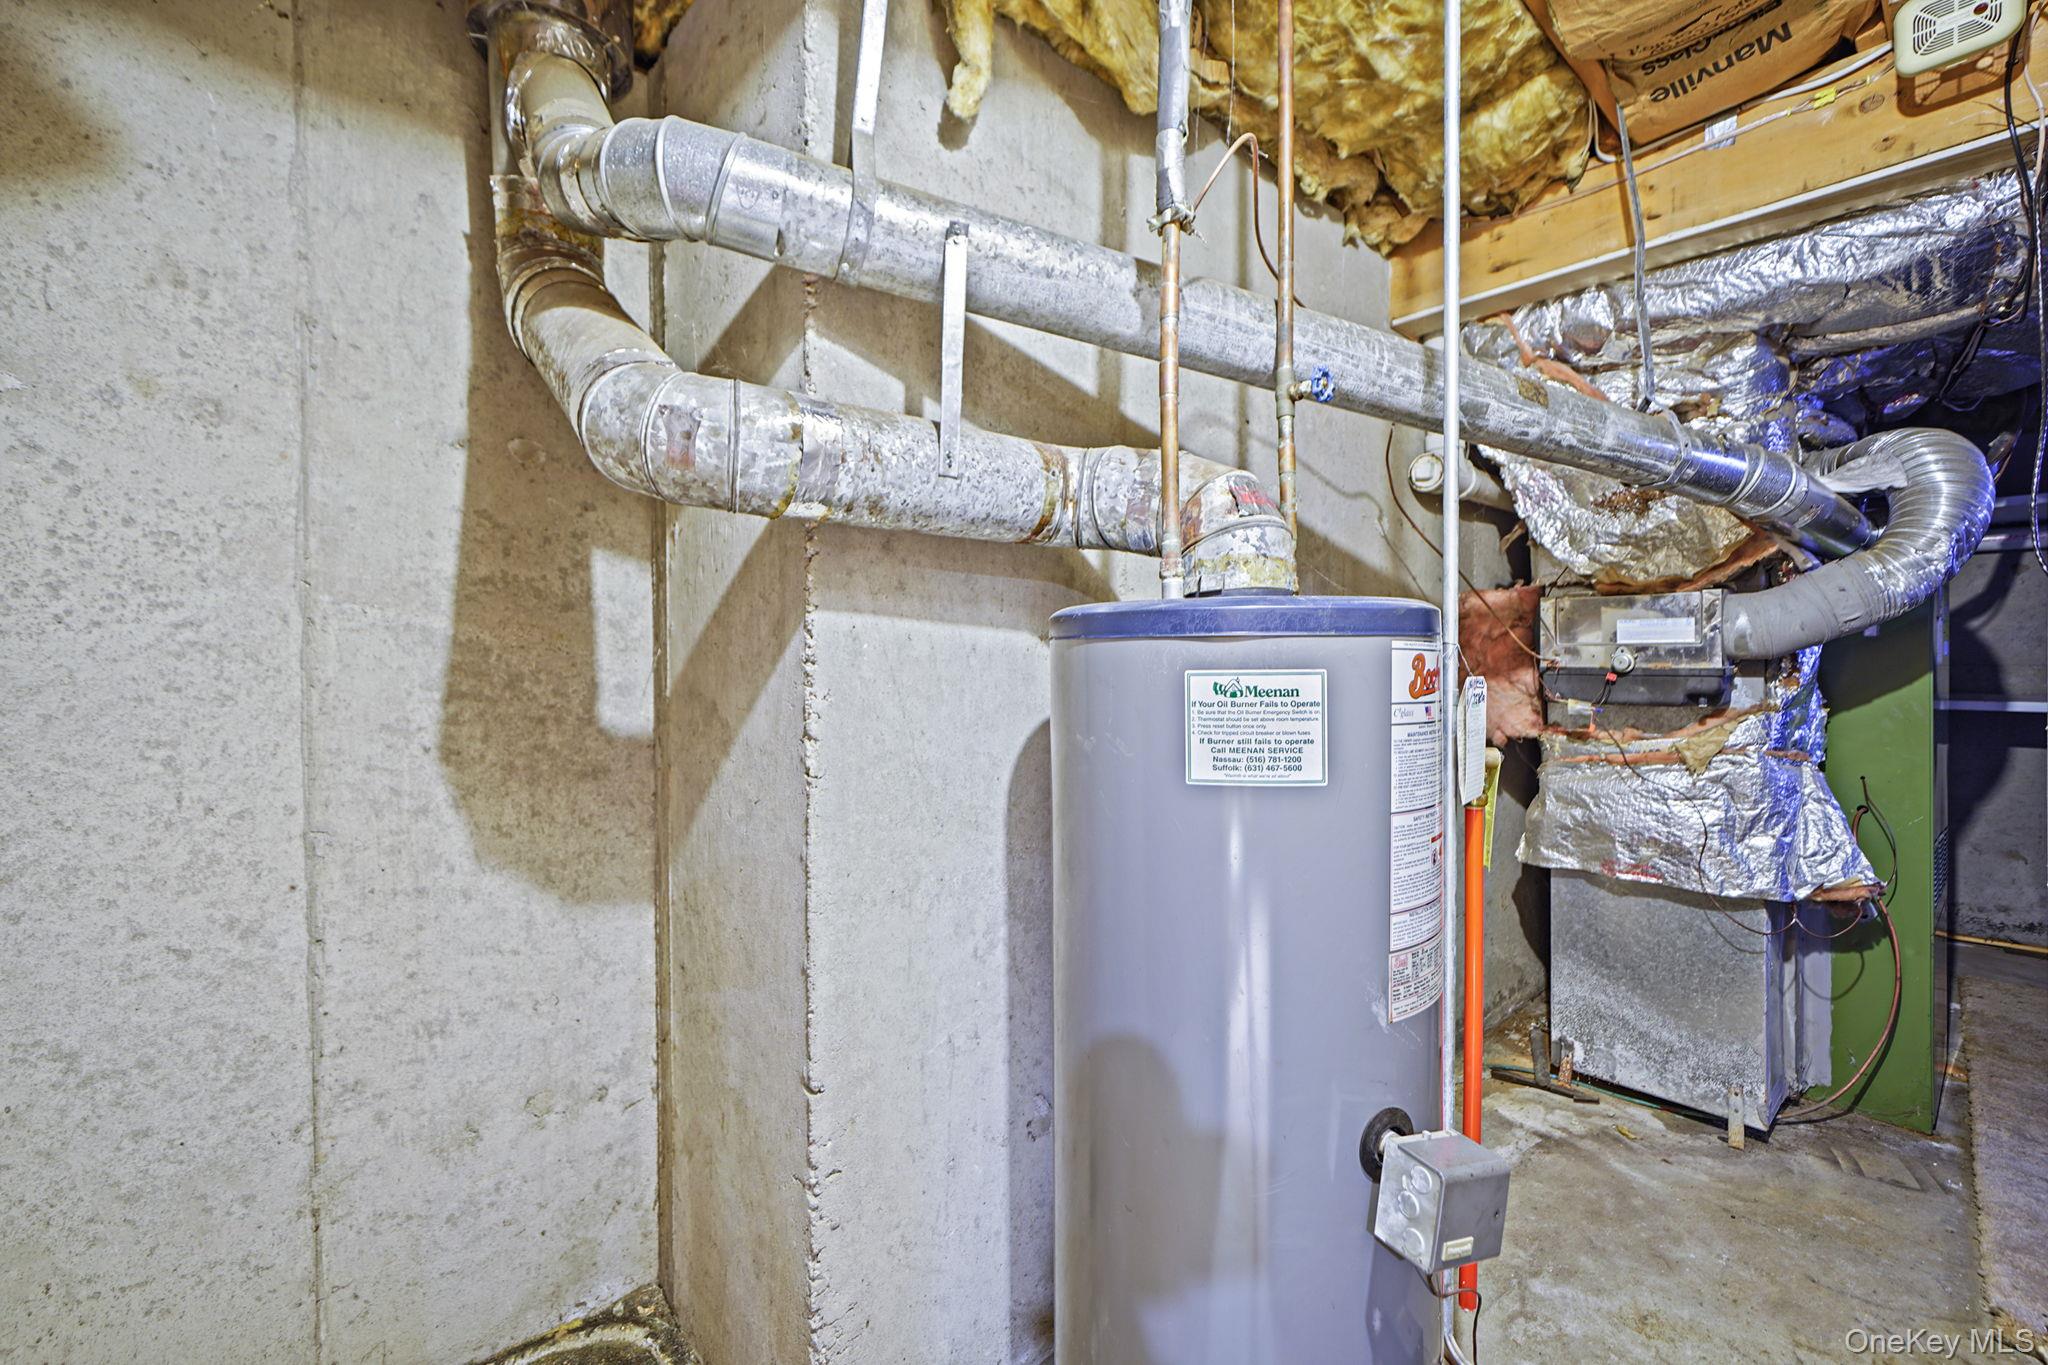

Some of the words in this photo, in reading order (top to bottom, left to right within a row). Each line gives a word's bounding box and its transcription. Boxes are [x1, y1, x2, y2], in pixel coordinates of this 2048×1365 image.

[1650, 21, 1793, 102] Manville
[1409, 652, 1440, 699] Boc
[1244, 686, 1300, 698] Meenan
[1191, 700, 1197, 708] If
[1198, 700, 1215, 708] Your
[1217, 700, 1228, 708] Oil
[1230, 700, 1258, 708] Burner
[1259, 700, 1279, 708] Fails
[1280, 700, 1289, 708] to
[1290, 700, 1320, 709] Operate
[1284, 738, 1315, 747] operate
[1210, 746, 1226, 754] Call
[1228, 746, 1265, 754] MEENAN
[1267, 746, 1304, 754] SERVICE
[1246, 755, 1266, 764] (516)
[1244, 764, 1264, 773] (631)
